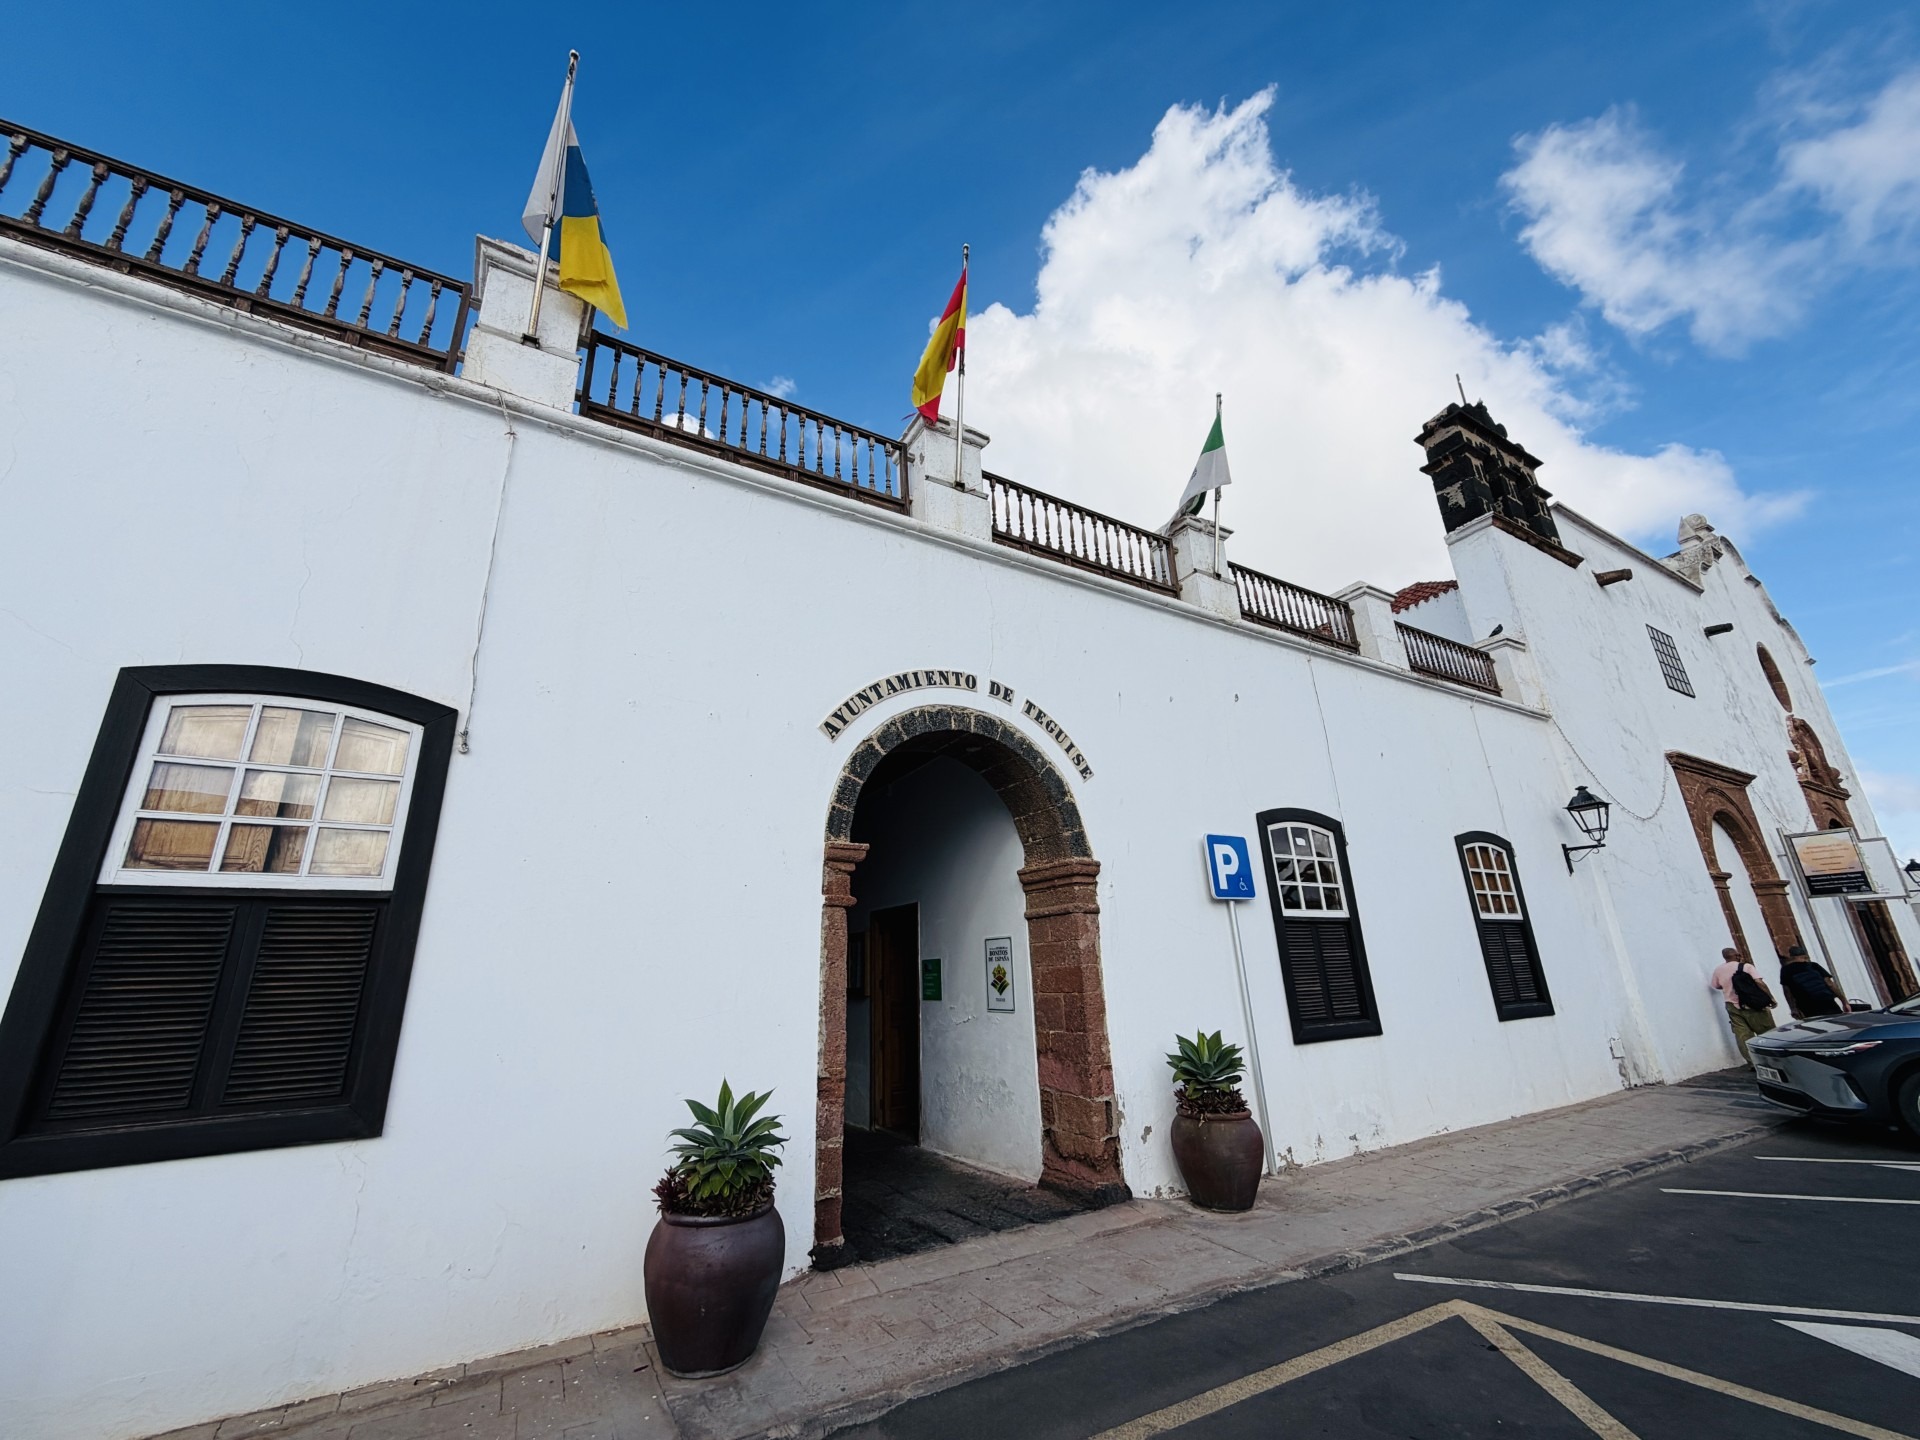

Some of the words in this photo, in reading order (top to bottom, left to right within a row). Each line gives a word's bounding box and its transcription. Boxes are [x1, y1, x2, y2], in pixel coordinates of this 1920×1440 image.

[822, 670, 977, 739] AYUNTAMIENTO
[990, 681, 1014, 702] DE
[1025, 700, 1092, 780] TEGUISE
[1213, 843, 1239, 890] P
